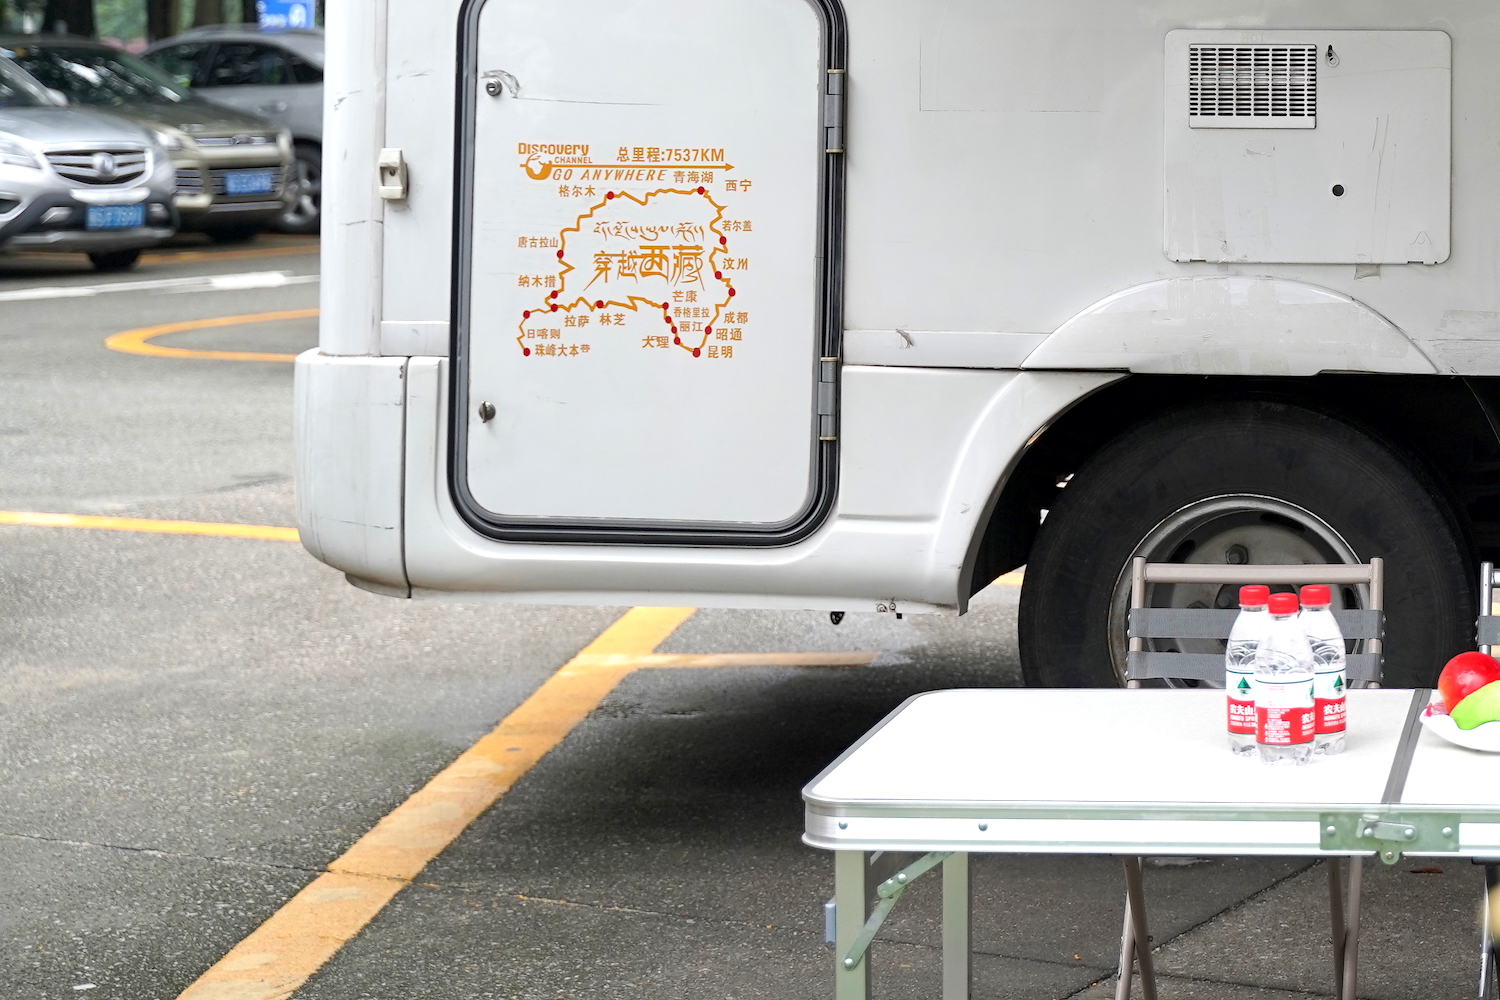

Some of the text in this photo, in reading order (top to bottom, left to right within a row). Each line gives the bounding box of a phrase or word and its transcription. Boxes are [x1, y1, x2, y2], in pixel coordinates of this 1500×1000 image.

[554, 156, 594, 165] CHANNEL
[552, 169, 668, 181] GO ANYWHERE
[672, 171, 714, 183] 青海湖
[558, 185, 596, 197] 格尔木
[725, 179, 752, 192] 西宁
[721, 220, 752, 233] 若尔盖
[517, 237, 559, 248] 唐古拉山
[585, 244, 708, 292] 穿越西藏
[672, 290, 697, 302] 芒康
[673, 307, 710, 318] 香格里拉
[723, 311, 749, 324] 成都
[564, 315, 589, 327] 拉萨
[599, 313, 625, 325] 林芝
[678, 321, 704, 333] 丽江
[526, 328, 561, 339] 日喀则
[715, 328, 743, 341] 昭通
[642, 336, 669, 348] 大理
[707, 346, 733, 358] 昆明
